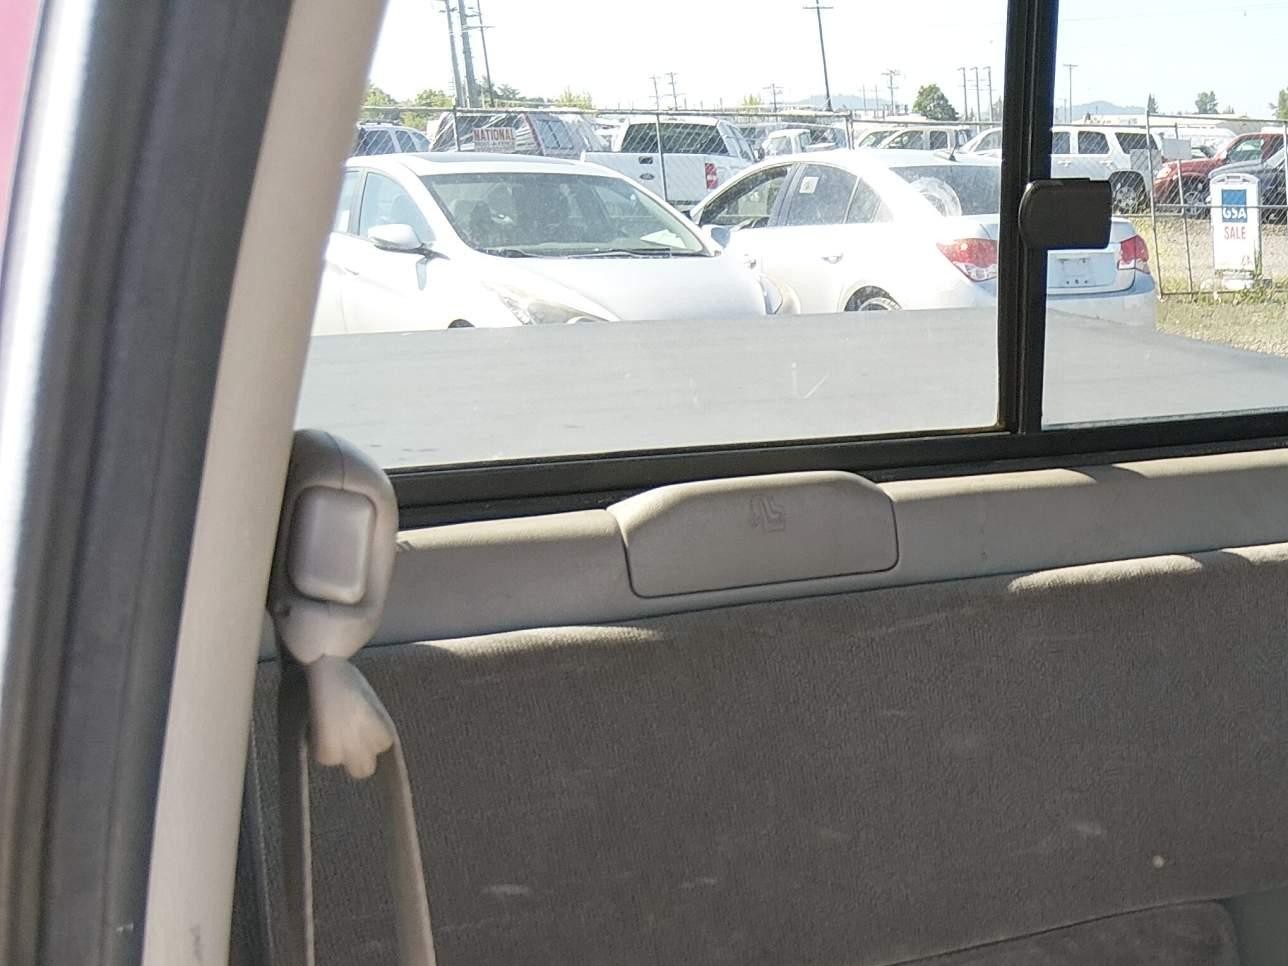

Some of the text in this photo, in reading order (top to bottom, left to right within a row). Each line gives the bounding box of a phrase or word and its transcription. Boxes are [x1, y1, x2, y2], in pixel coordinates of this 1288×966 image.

[473, 128, 513, 141] NATIONAL
[1222, 207, 1247, 219] GSA
[1224, 226, 1246, 240] SALE
